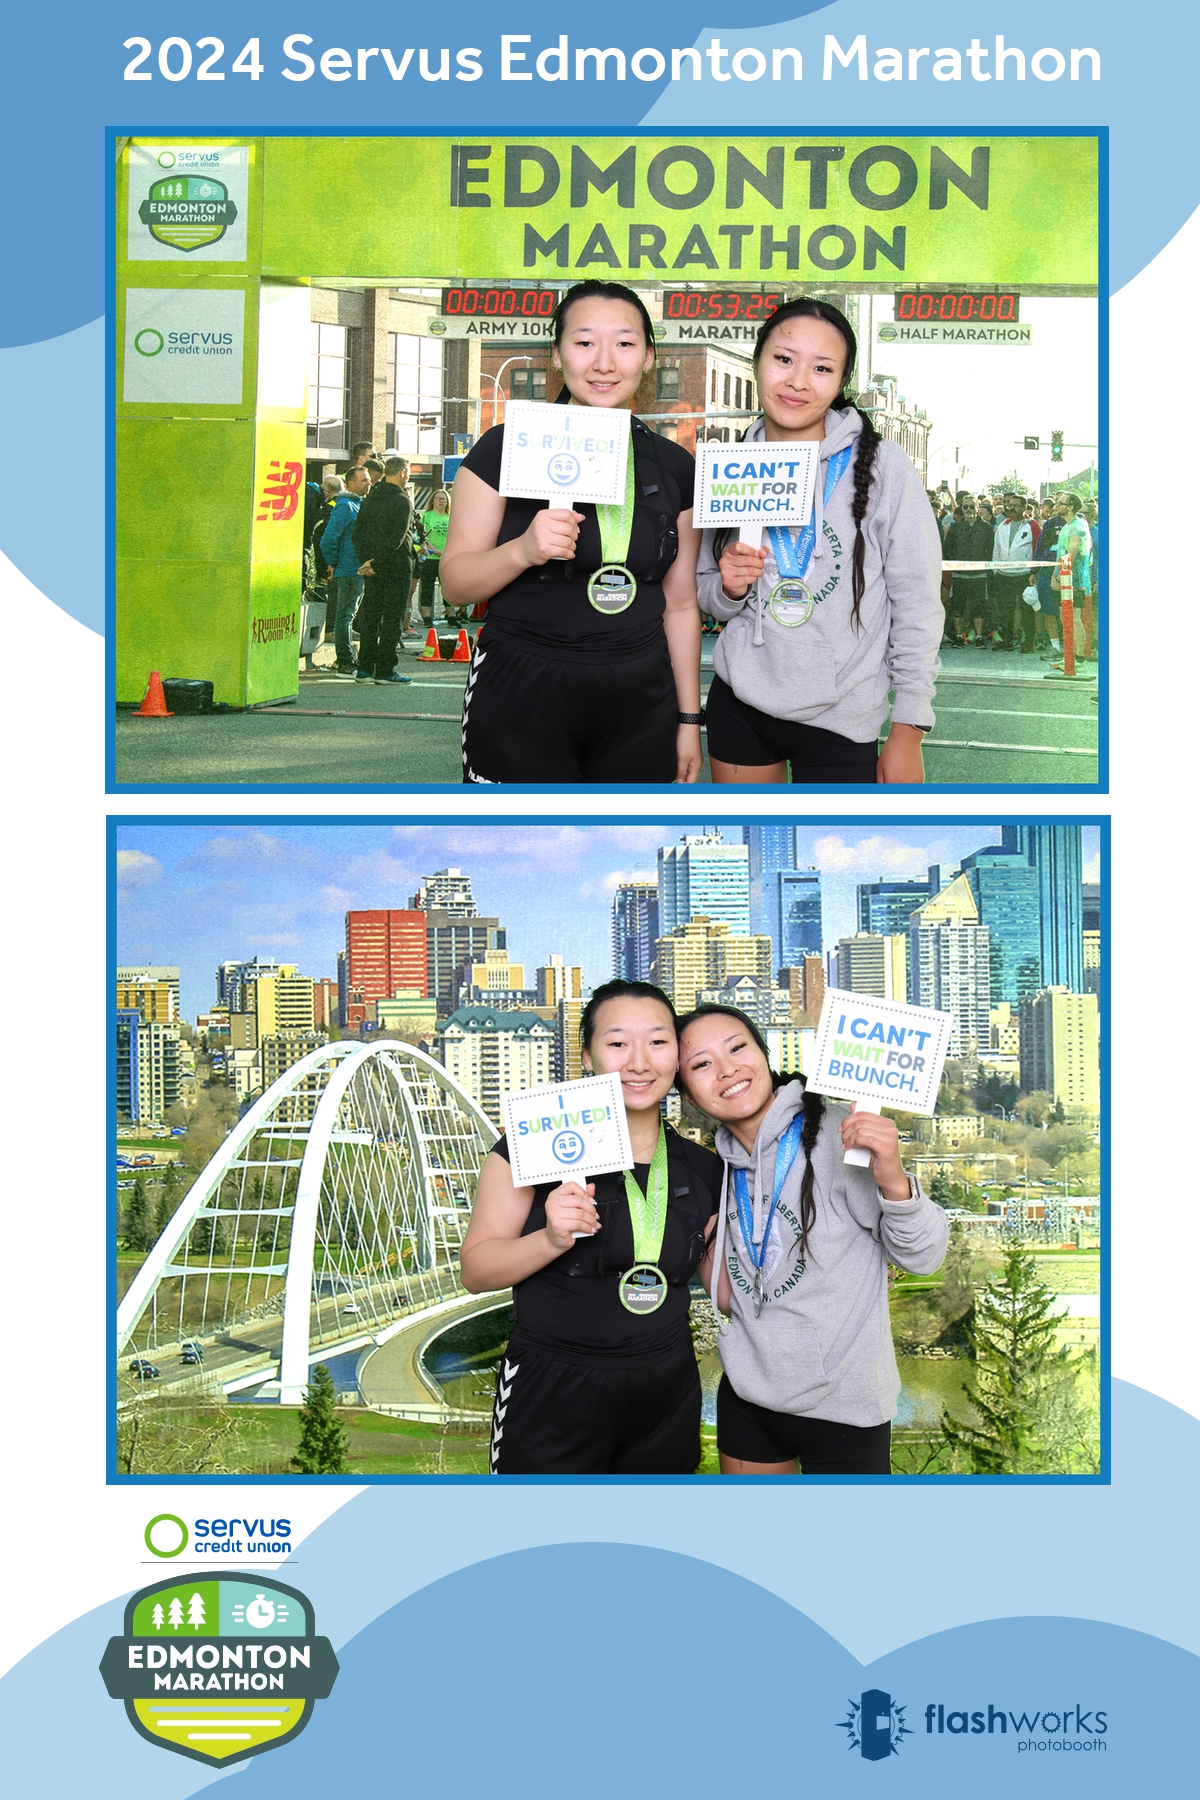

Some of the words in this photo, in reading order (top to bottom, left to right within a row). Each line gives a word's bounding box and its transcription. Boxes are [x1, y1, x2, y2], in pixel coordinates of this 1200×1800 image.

[178, 153, 219, 161] servus
[451, 144, 990, 211] EDMONTON
[149, 203, 227, 214] EDMONTON
[160, 214, 215, 222] MARATHON
[523, 223, 906, 271] MARATHON
[168, 332, 233, 345] servus
[465, 321, 518, 336] ARMY
[678, 325, 760, 340] MARATH
[900, 328, 939, 340] HALF
[942, 329, 1031, 341] MARATHON
[168, 345, 200, 355] credit
[203, 347, 233, 355] union
[564, 417, 570, 431] I
[517, 432, 615, 454] SURVIVED!
[712, 463, 719, 480] I
[710, 483, 759, 497] WAIT
[761, 482, 798, 496] FOR
[710, 498, 795, 513] BRUNCH.
[778, 539, 791, 570] FINISHER
[813, 576, 840, 604] NADA
[257, 613, 290, 643] Running
[837, 1014, 846, 1034] I
[833, 1038, 885, 1064] WAIT
[886, 1050, 926, 1073] FOR
[828, 1059, 919, 1093] BRUNCH.
[558, 1094, 564, 1109] I
[518, 1106, 611, 1136] SURVIVED!
[784, 1142, 792, 1163] credit
[740, 1198, 749, 1231] MARATHON
[776, 1199, 803, 1241] LBERTA
[728, 1256, 772, 1303] EDMONN,
[774, 1258, 807, 1299] CANADA
